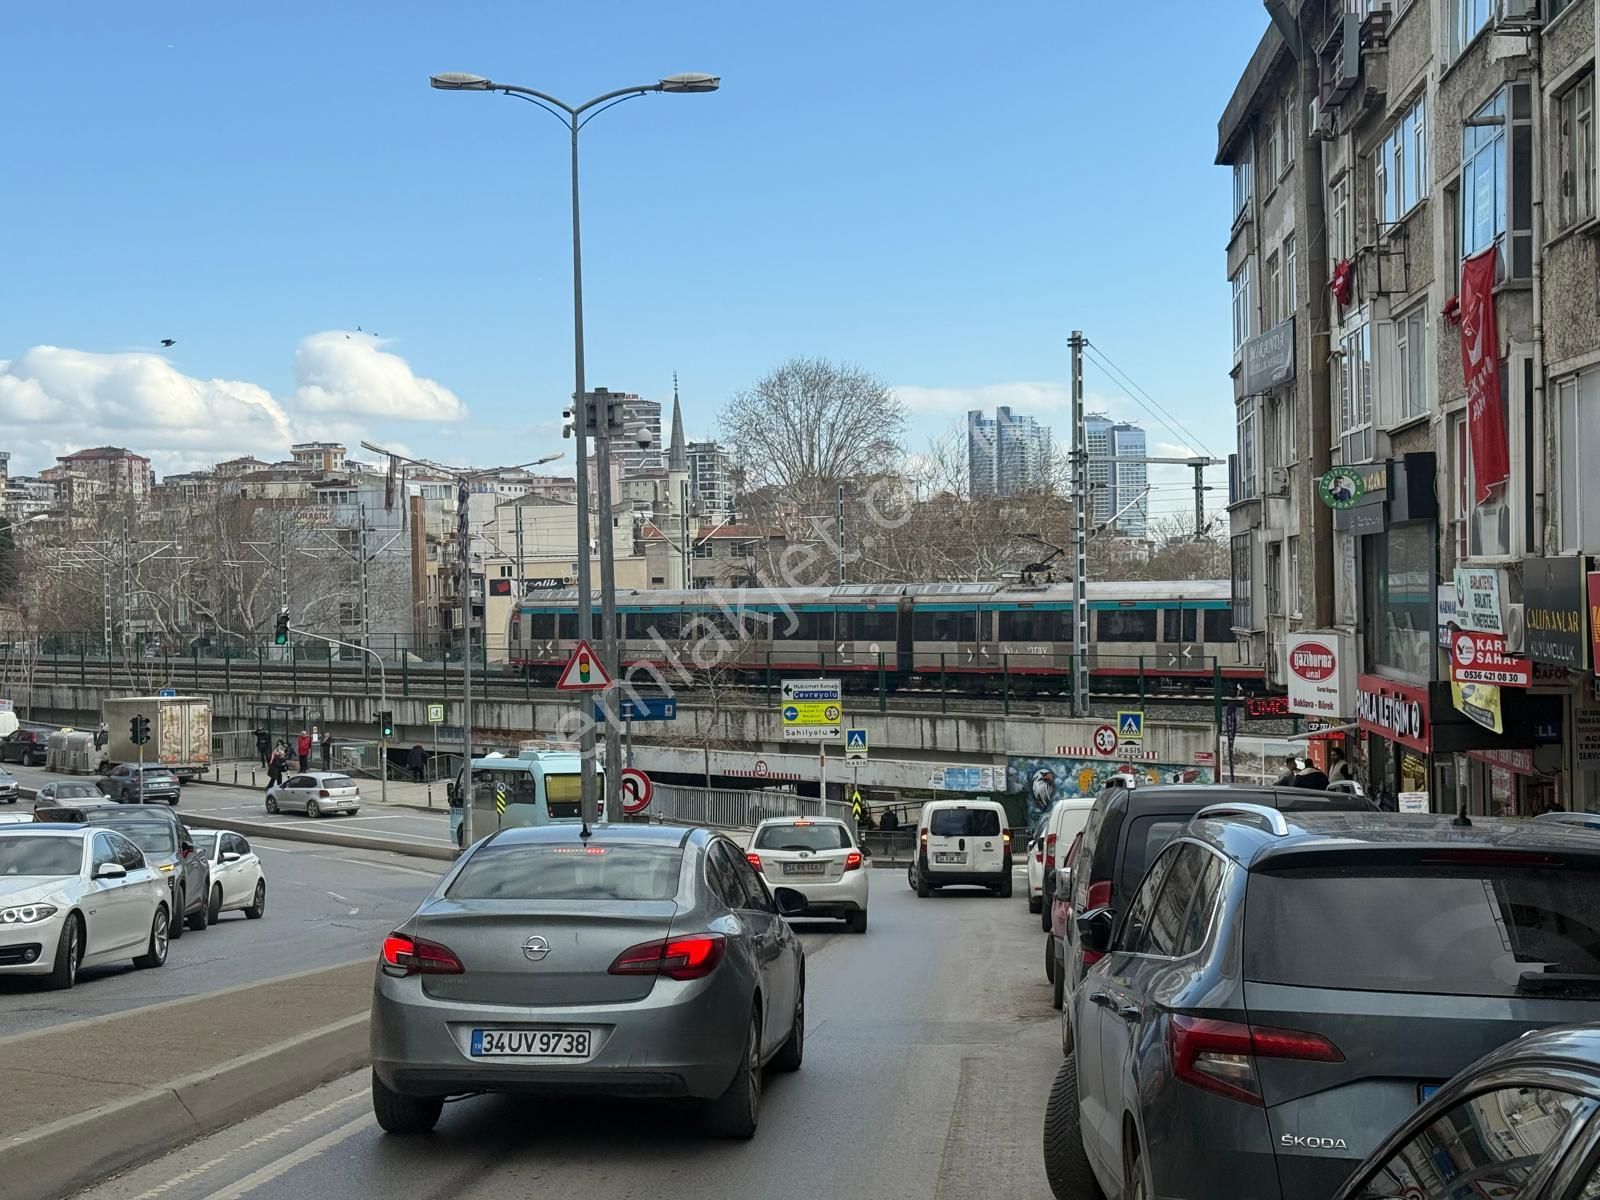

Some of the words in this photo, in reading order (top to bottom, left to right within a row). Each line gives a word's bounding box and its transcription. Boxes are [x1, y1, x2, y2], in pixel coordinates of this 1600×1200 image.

[1332, 499, 1355, 508] ADAM
[1464, 671, 1482, 680] 0536
[1483, 672, 1496, 680] 421
[1497, 673, 1507, 682] 08
[1508, 673, 1518, 682] 30
[793, 691, 838, 699] Çevreyolu
[1356, 688, 1377, 724] PARLA
[785, 729, 828, 737] Sahilyolu
[1098, 732, 1105, 747] 3
